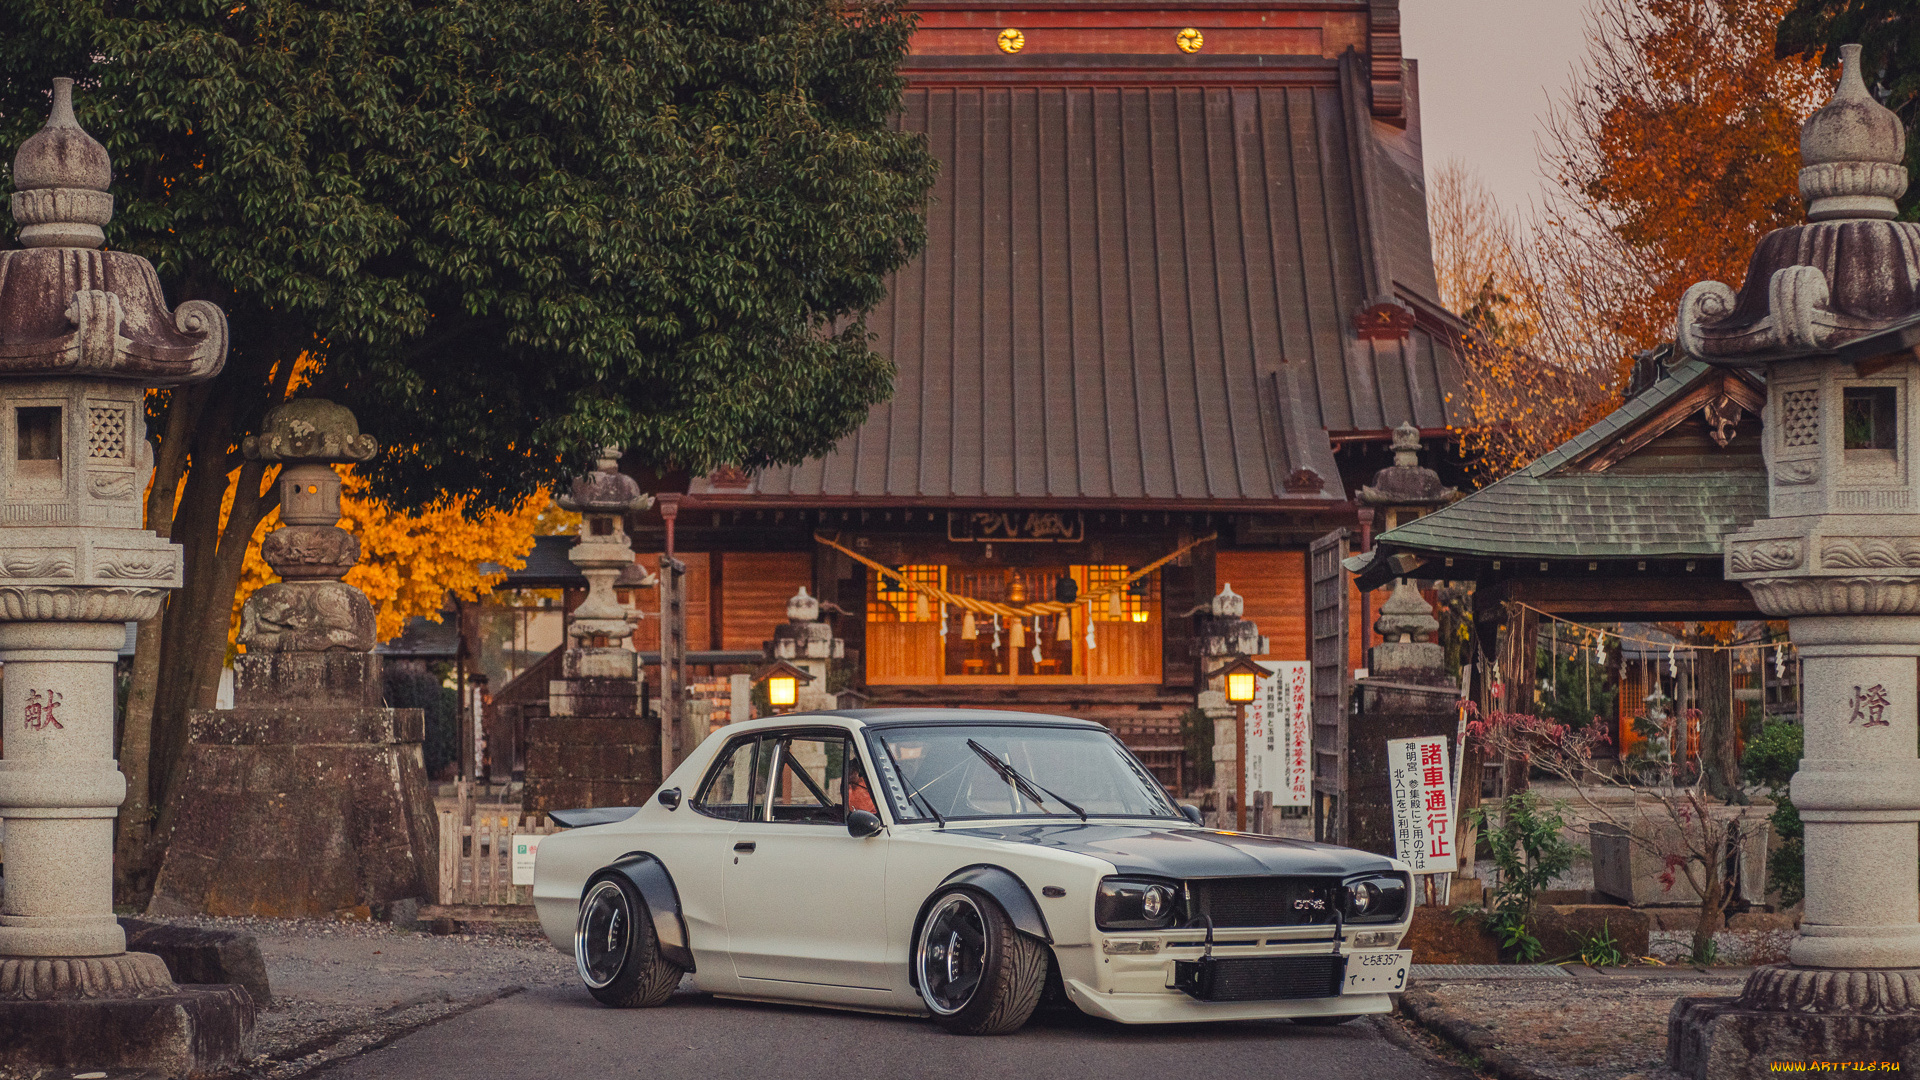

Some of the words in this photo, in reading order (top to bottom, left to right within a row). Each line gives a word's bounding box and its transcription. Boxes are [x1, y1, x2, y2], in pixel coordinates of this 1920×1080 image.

[24, 688, 64, 731] 献
[1849, 684, 1891, 728] 燈
[1405, 742, 1425, 869] 神明宮、参集殿にご用の方は
[1420, 743, 1450, 858] 諸車通行止
